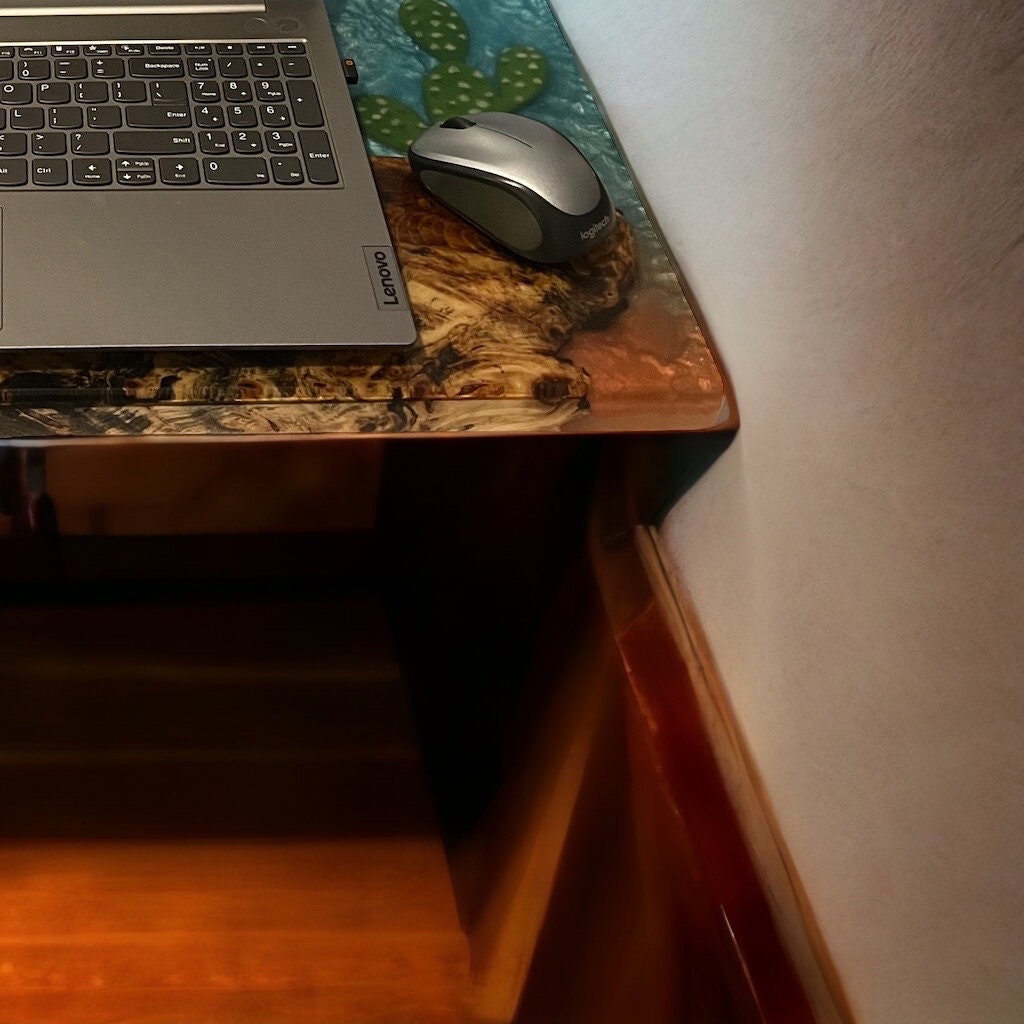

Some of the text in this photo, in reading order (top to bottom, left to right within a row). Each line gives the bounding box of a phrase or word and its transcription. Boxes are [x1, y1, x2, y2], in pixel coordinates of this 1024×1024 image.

[22, 69, 30, 77] 0
[3, 84, 15, 93] O
[41, 83, 50, 92] P
[197, 82, 205, 90] 7
[229, 81, 238, 90] 8
[261, 81, 270, 90] 9
[14, 109, 22, 118] L
[201, 106, 209, 115] 4
[233, 106, 242, 115] 5
[266, 105, 275, 114] 6
[238, 132, 247, 141] 2
[272, 131, 281, 140] 3
[209, 161, 218, 171] 0
[581, 216, 610, 240] logitech
[374, 251, 398, 305] Lenovo
